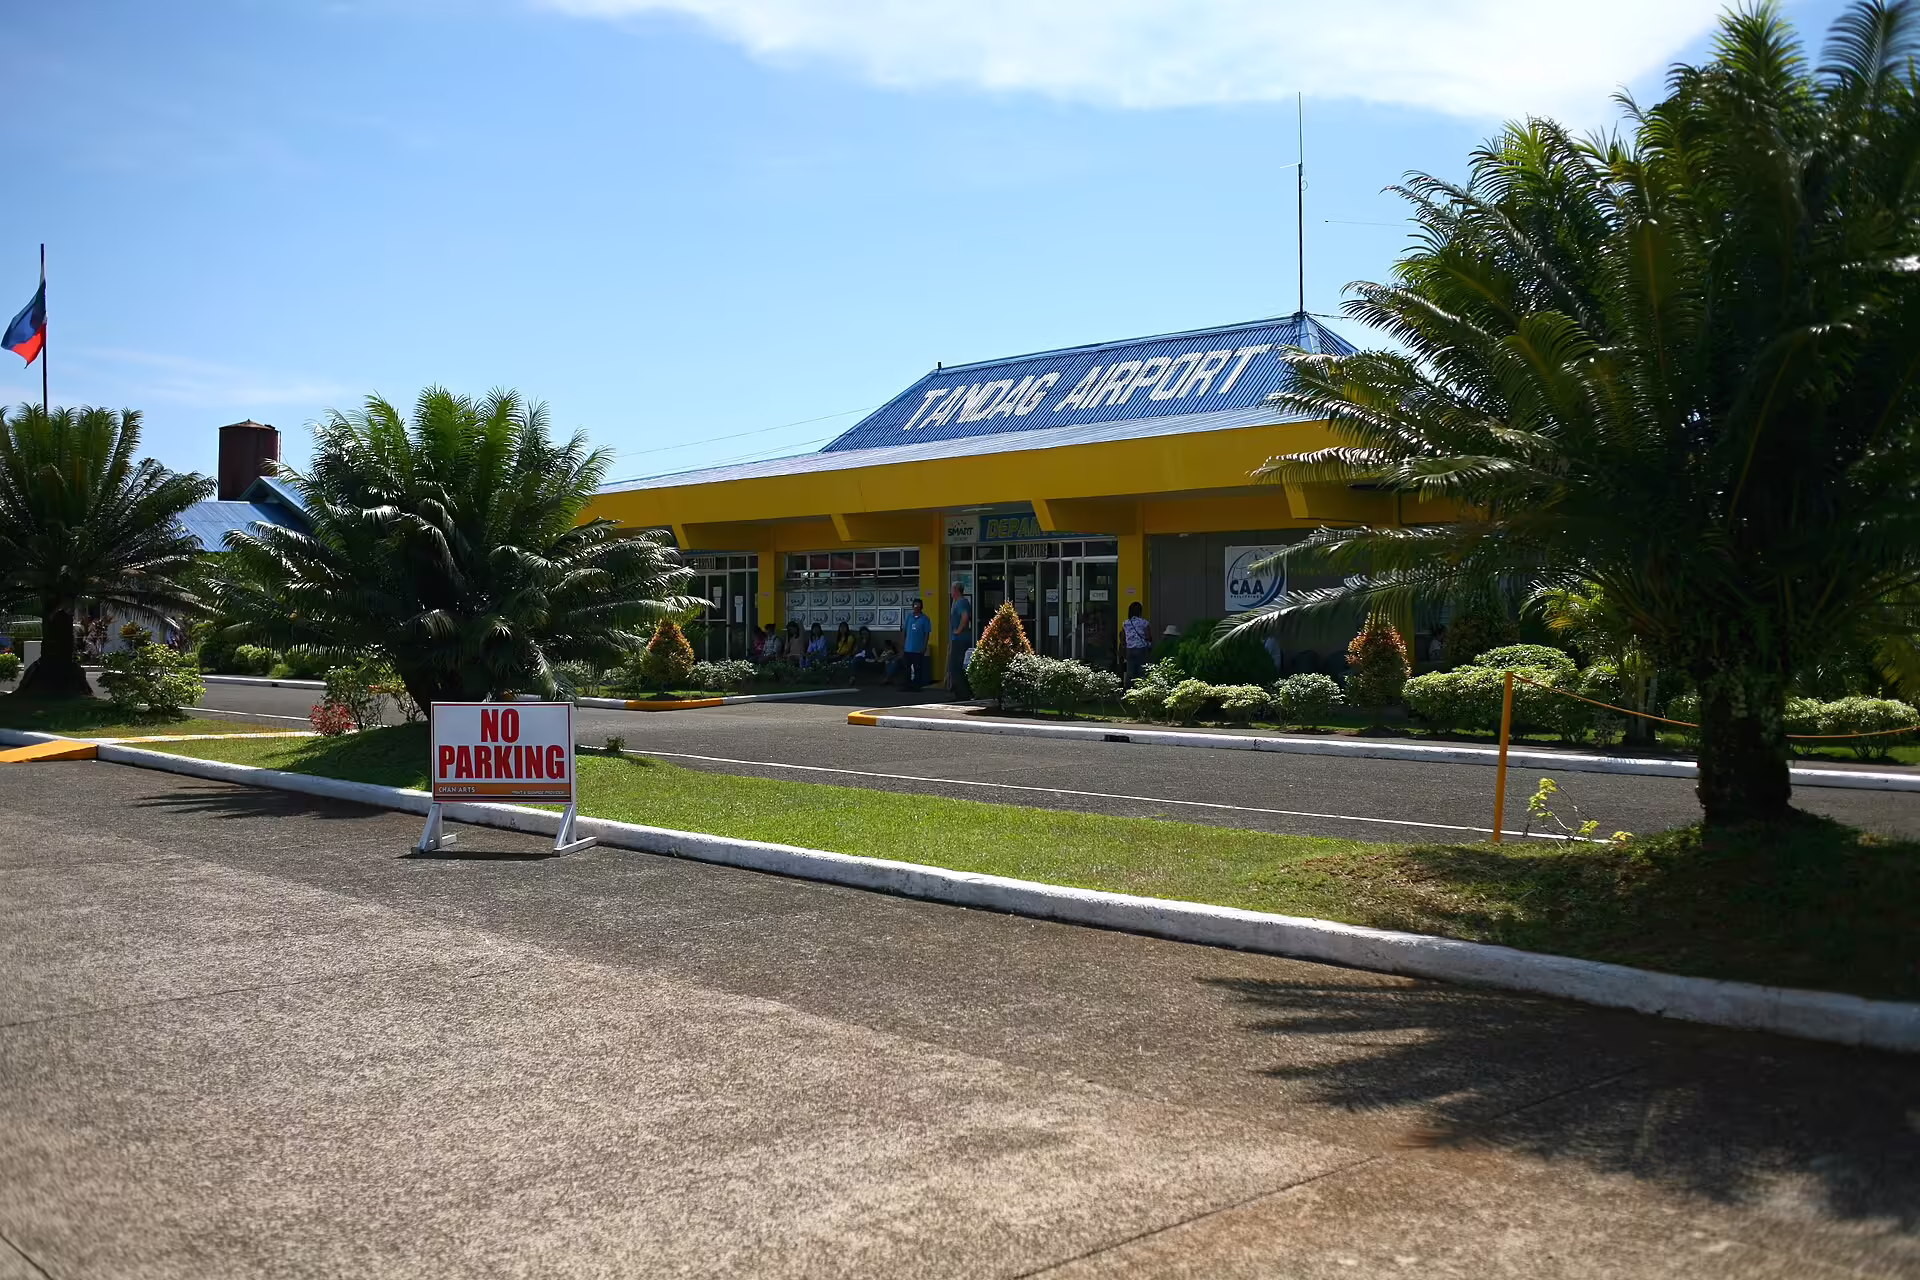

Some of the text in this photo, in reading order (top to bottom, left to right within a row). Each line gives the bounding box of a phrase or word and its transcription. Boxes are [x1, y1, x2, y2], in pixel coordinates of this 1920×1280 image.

[904, 343, 1273, 430] TANDAG AIRPORT
[948, 527, 974, 536] SMART
[1230, 580, 1264, 595] CAA
[481, 708, 520, 743] NO
[438, 745, 565, 779] PARKING
